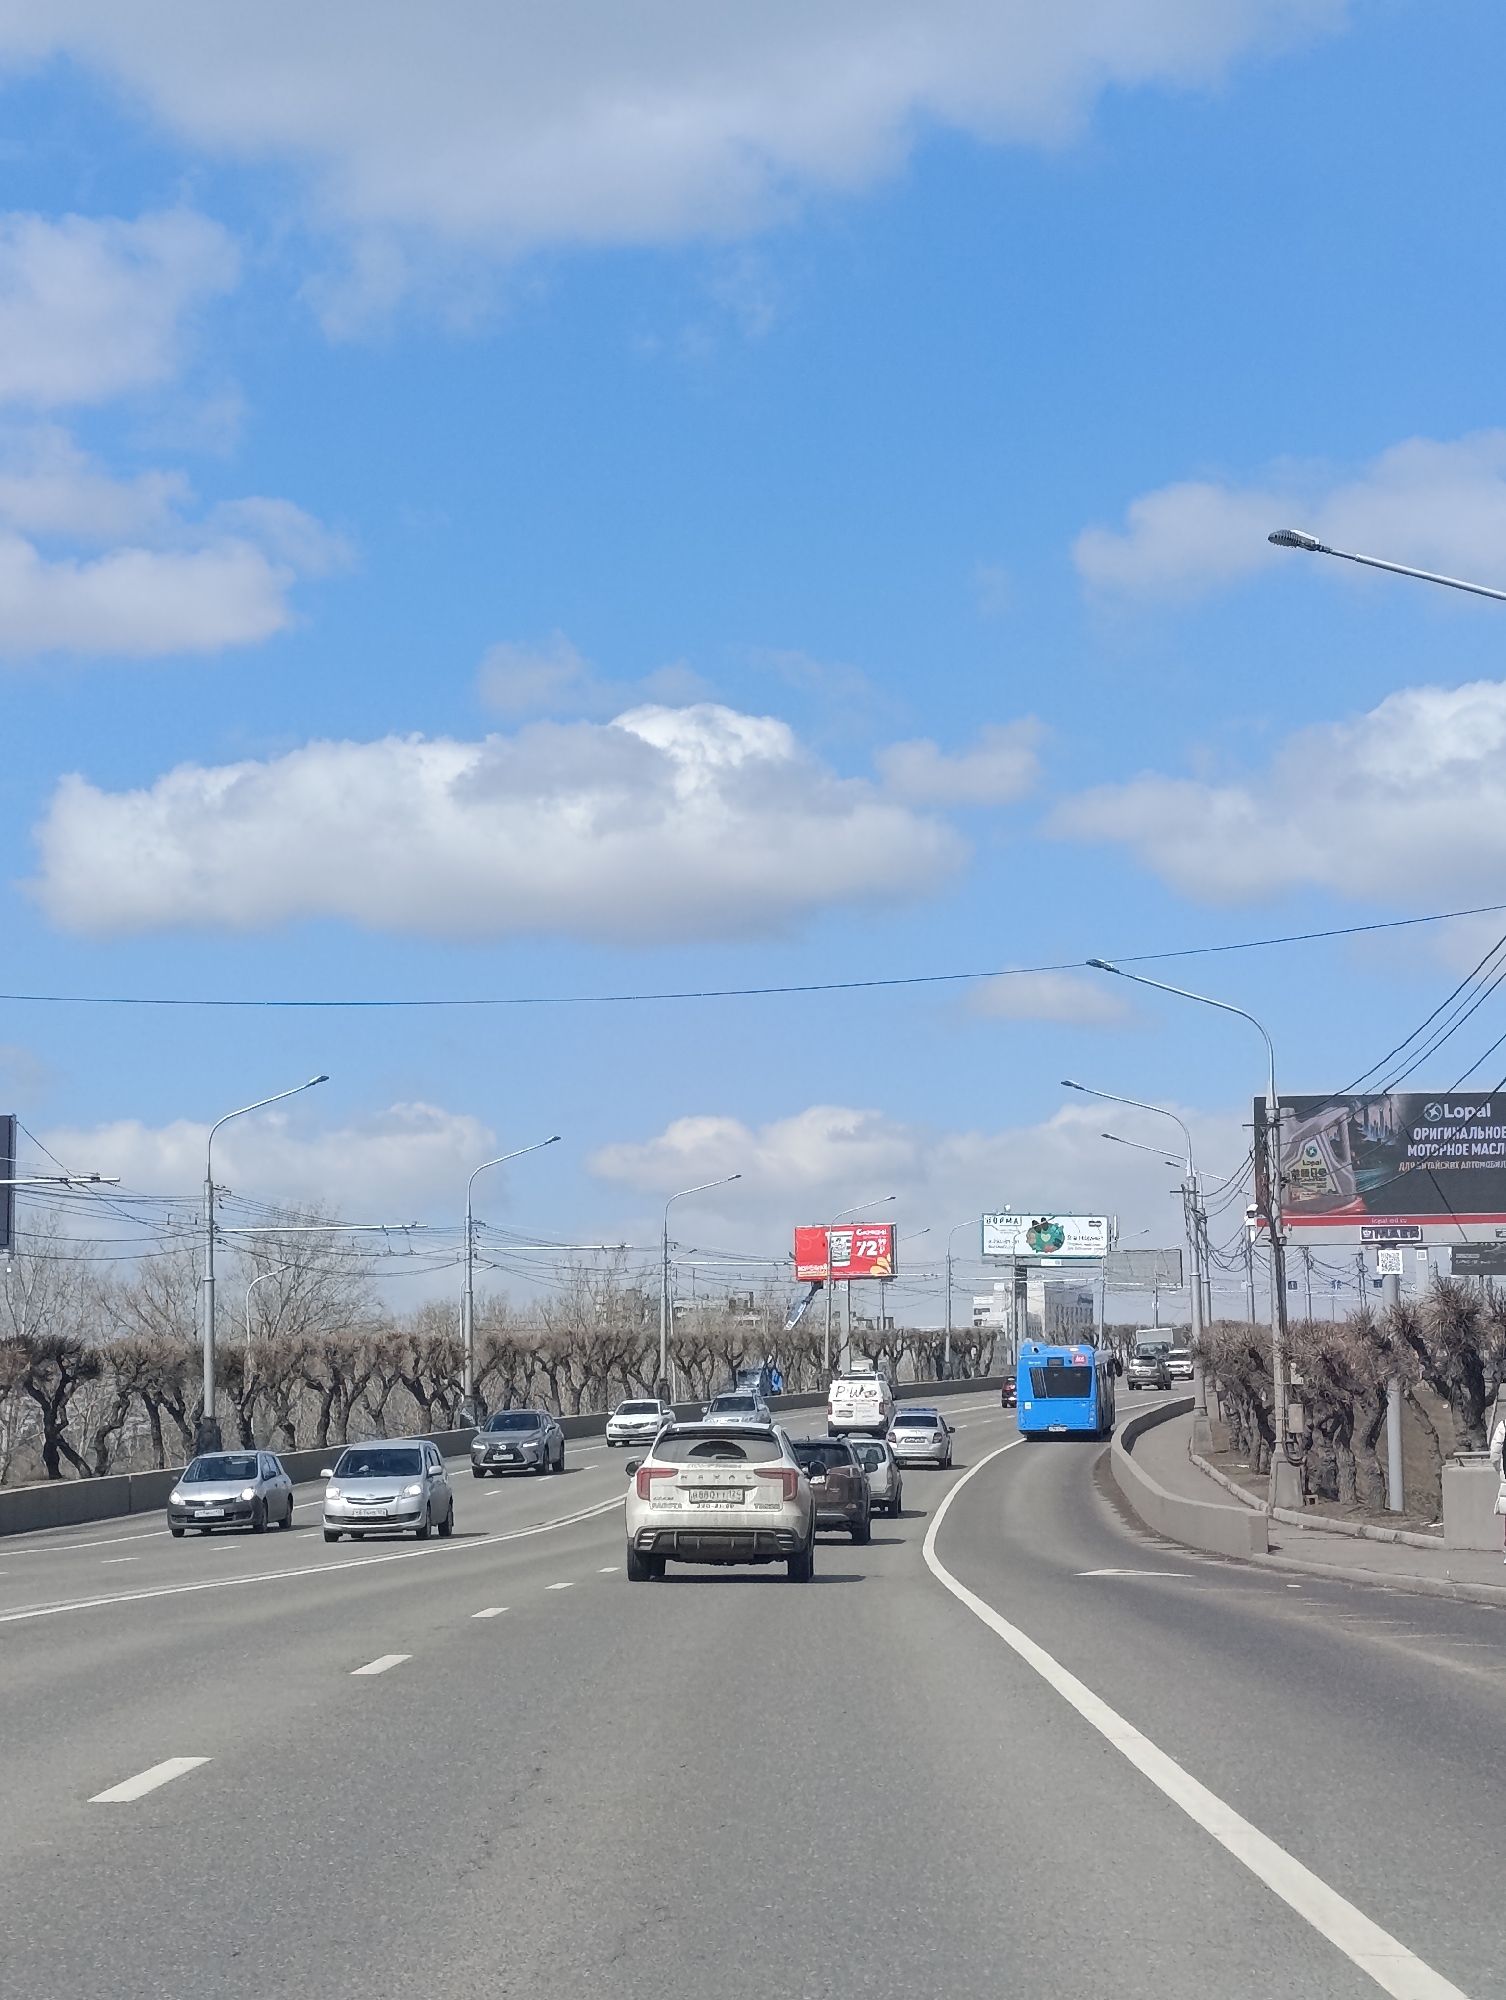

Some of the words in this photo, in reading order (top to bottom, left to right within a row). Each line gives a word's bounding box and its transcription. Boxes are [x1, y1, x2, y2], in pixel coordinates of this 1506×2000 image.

[1443, 1102, 1491, 1121] Lopal
[1413, 1125, 1506, 1141] ОРИГИНАЛЬНОЕ
[1407, 1142, 1469, 1157] МОТОРНОЕ
[1471, 1142, 1506, 1156] МАСЛ
[856, 1240, 878, 1257] 72
